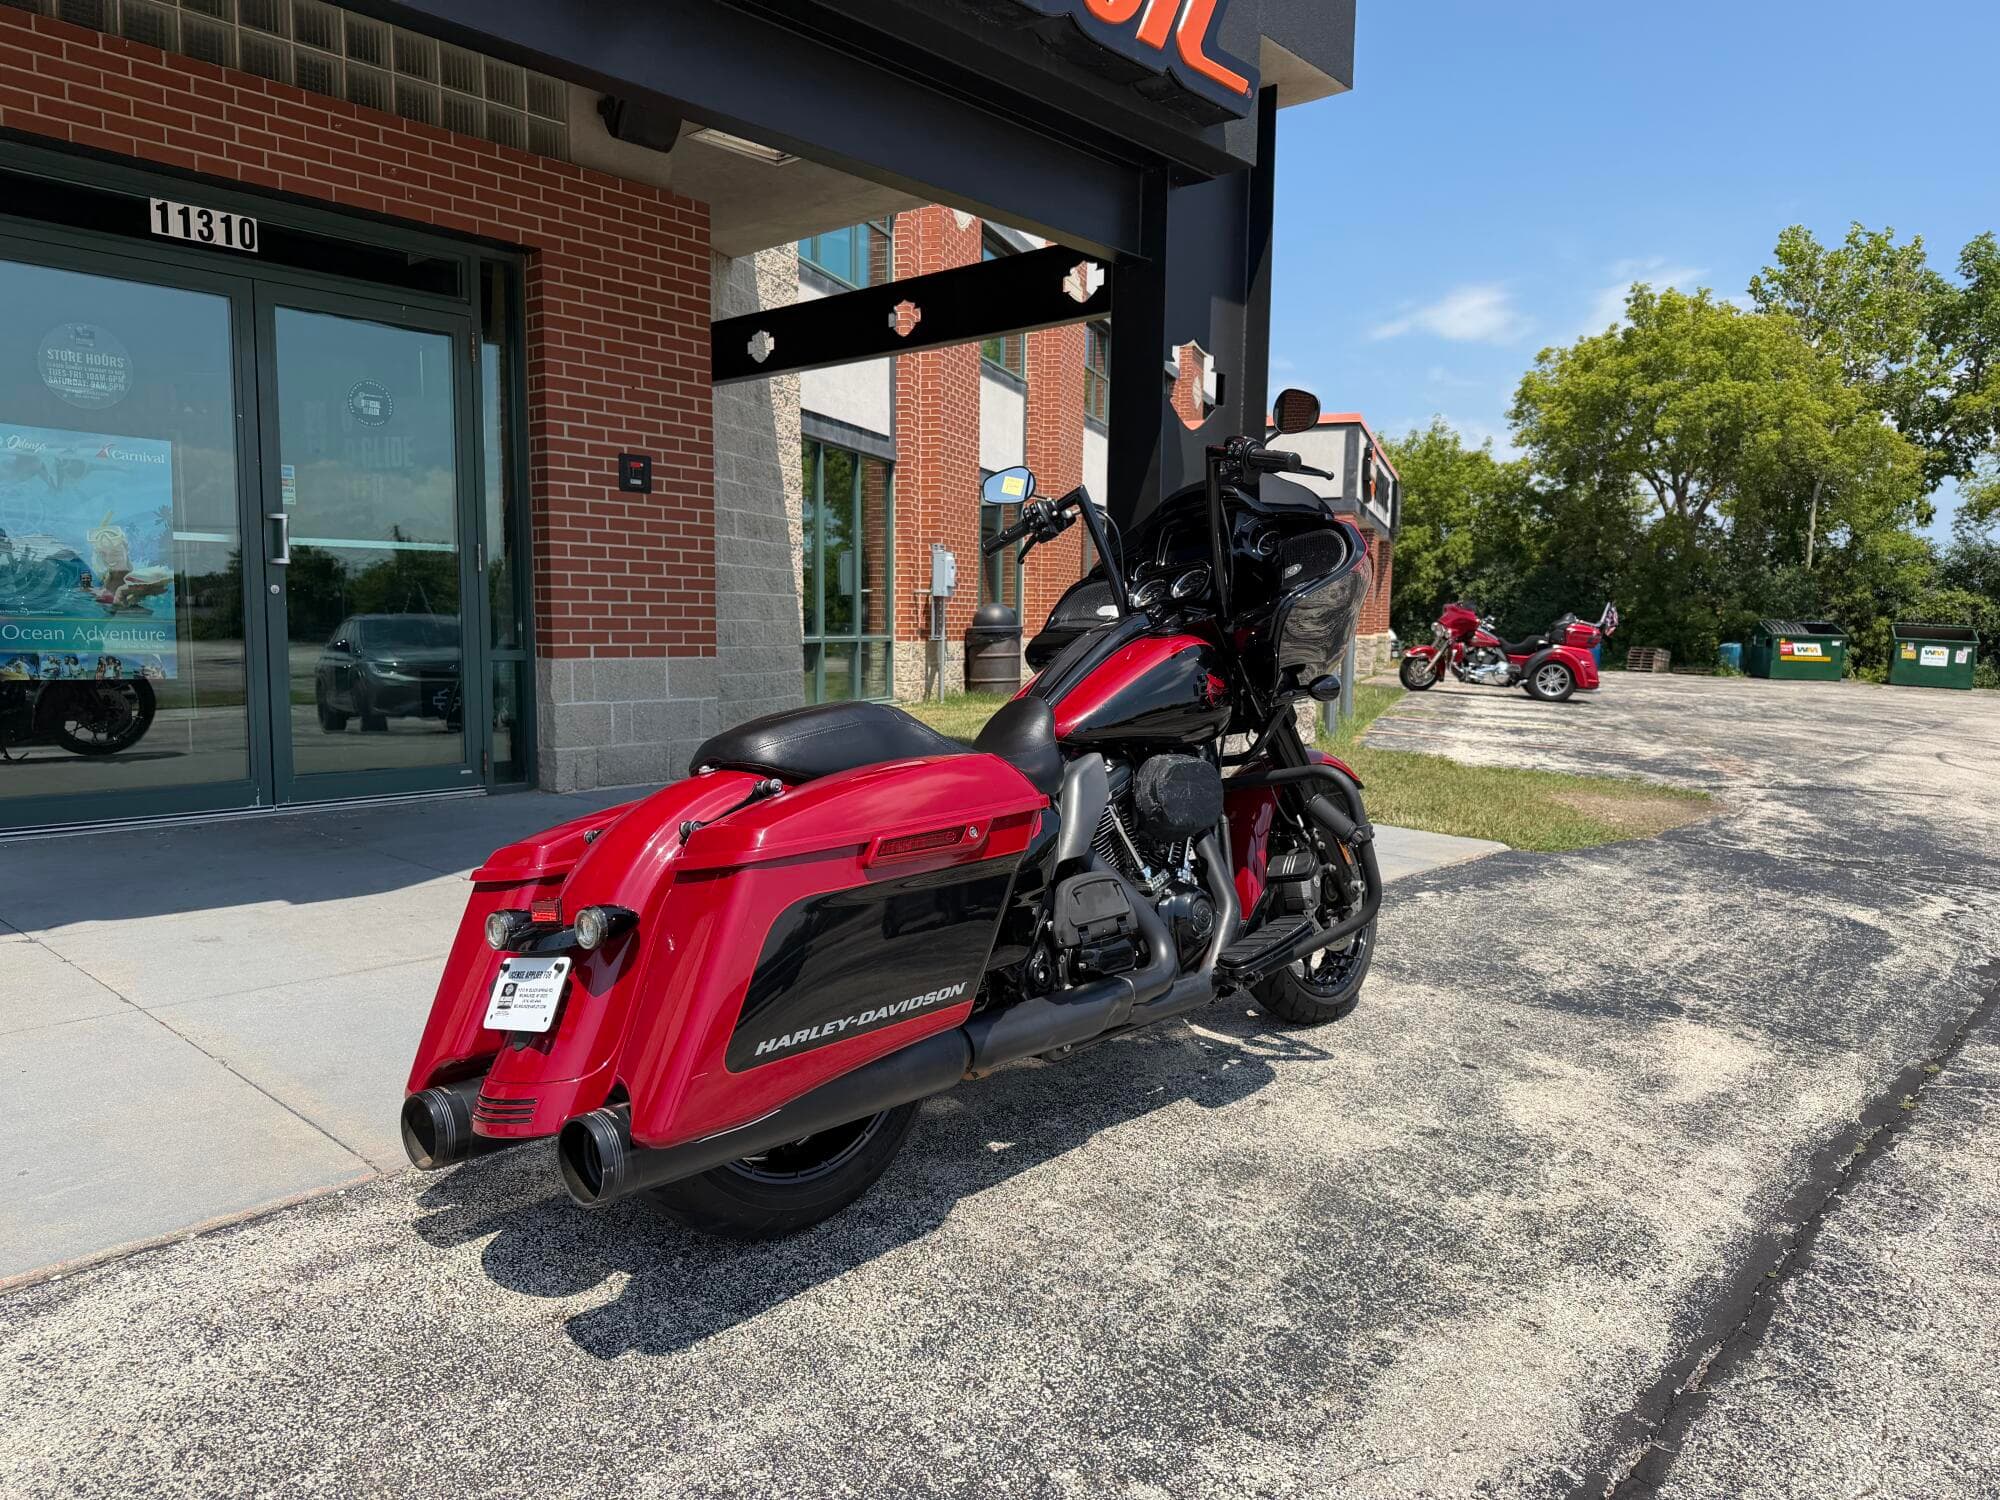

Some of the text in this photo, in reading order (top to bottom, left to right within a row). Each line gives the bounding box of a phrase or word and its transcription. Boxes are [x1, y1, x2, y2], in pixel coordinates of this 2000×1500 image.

[155, 201, 256, 250] 11310
[47, 349, 83, 363] STORE
[86, 353, 125, 368] HOURS
[111, 449, 165, 464] Carnival
[1, 624, 166, 642] Ocean Adventure
[754, 981, 968, 1056] HARLEY-DAVIDSON
